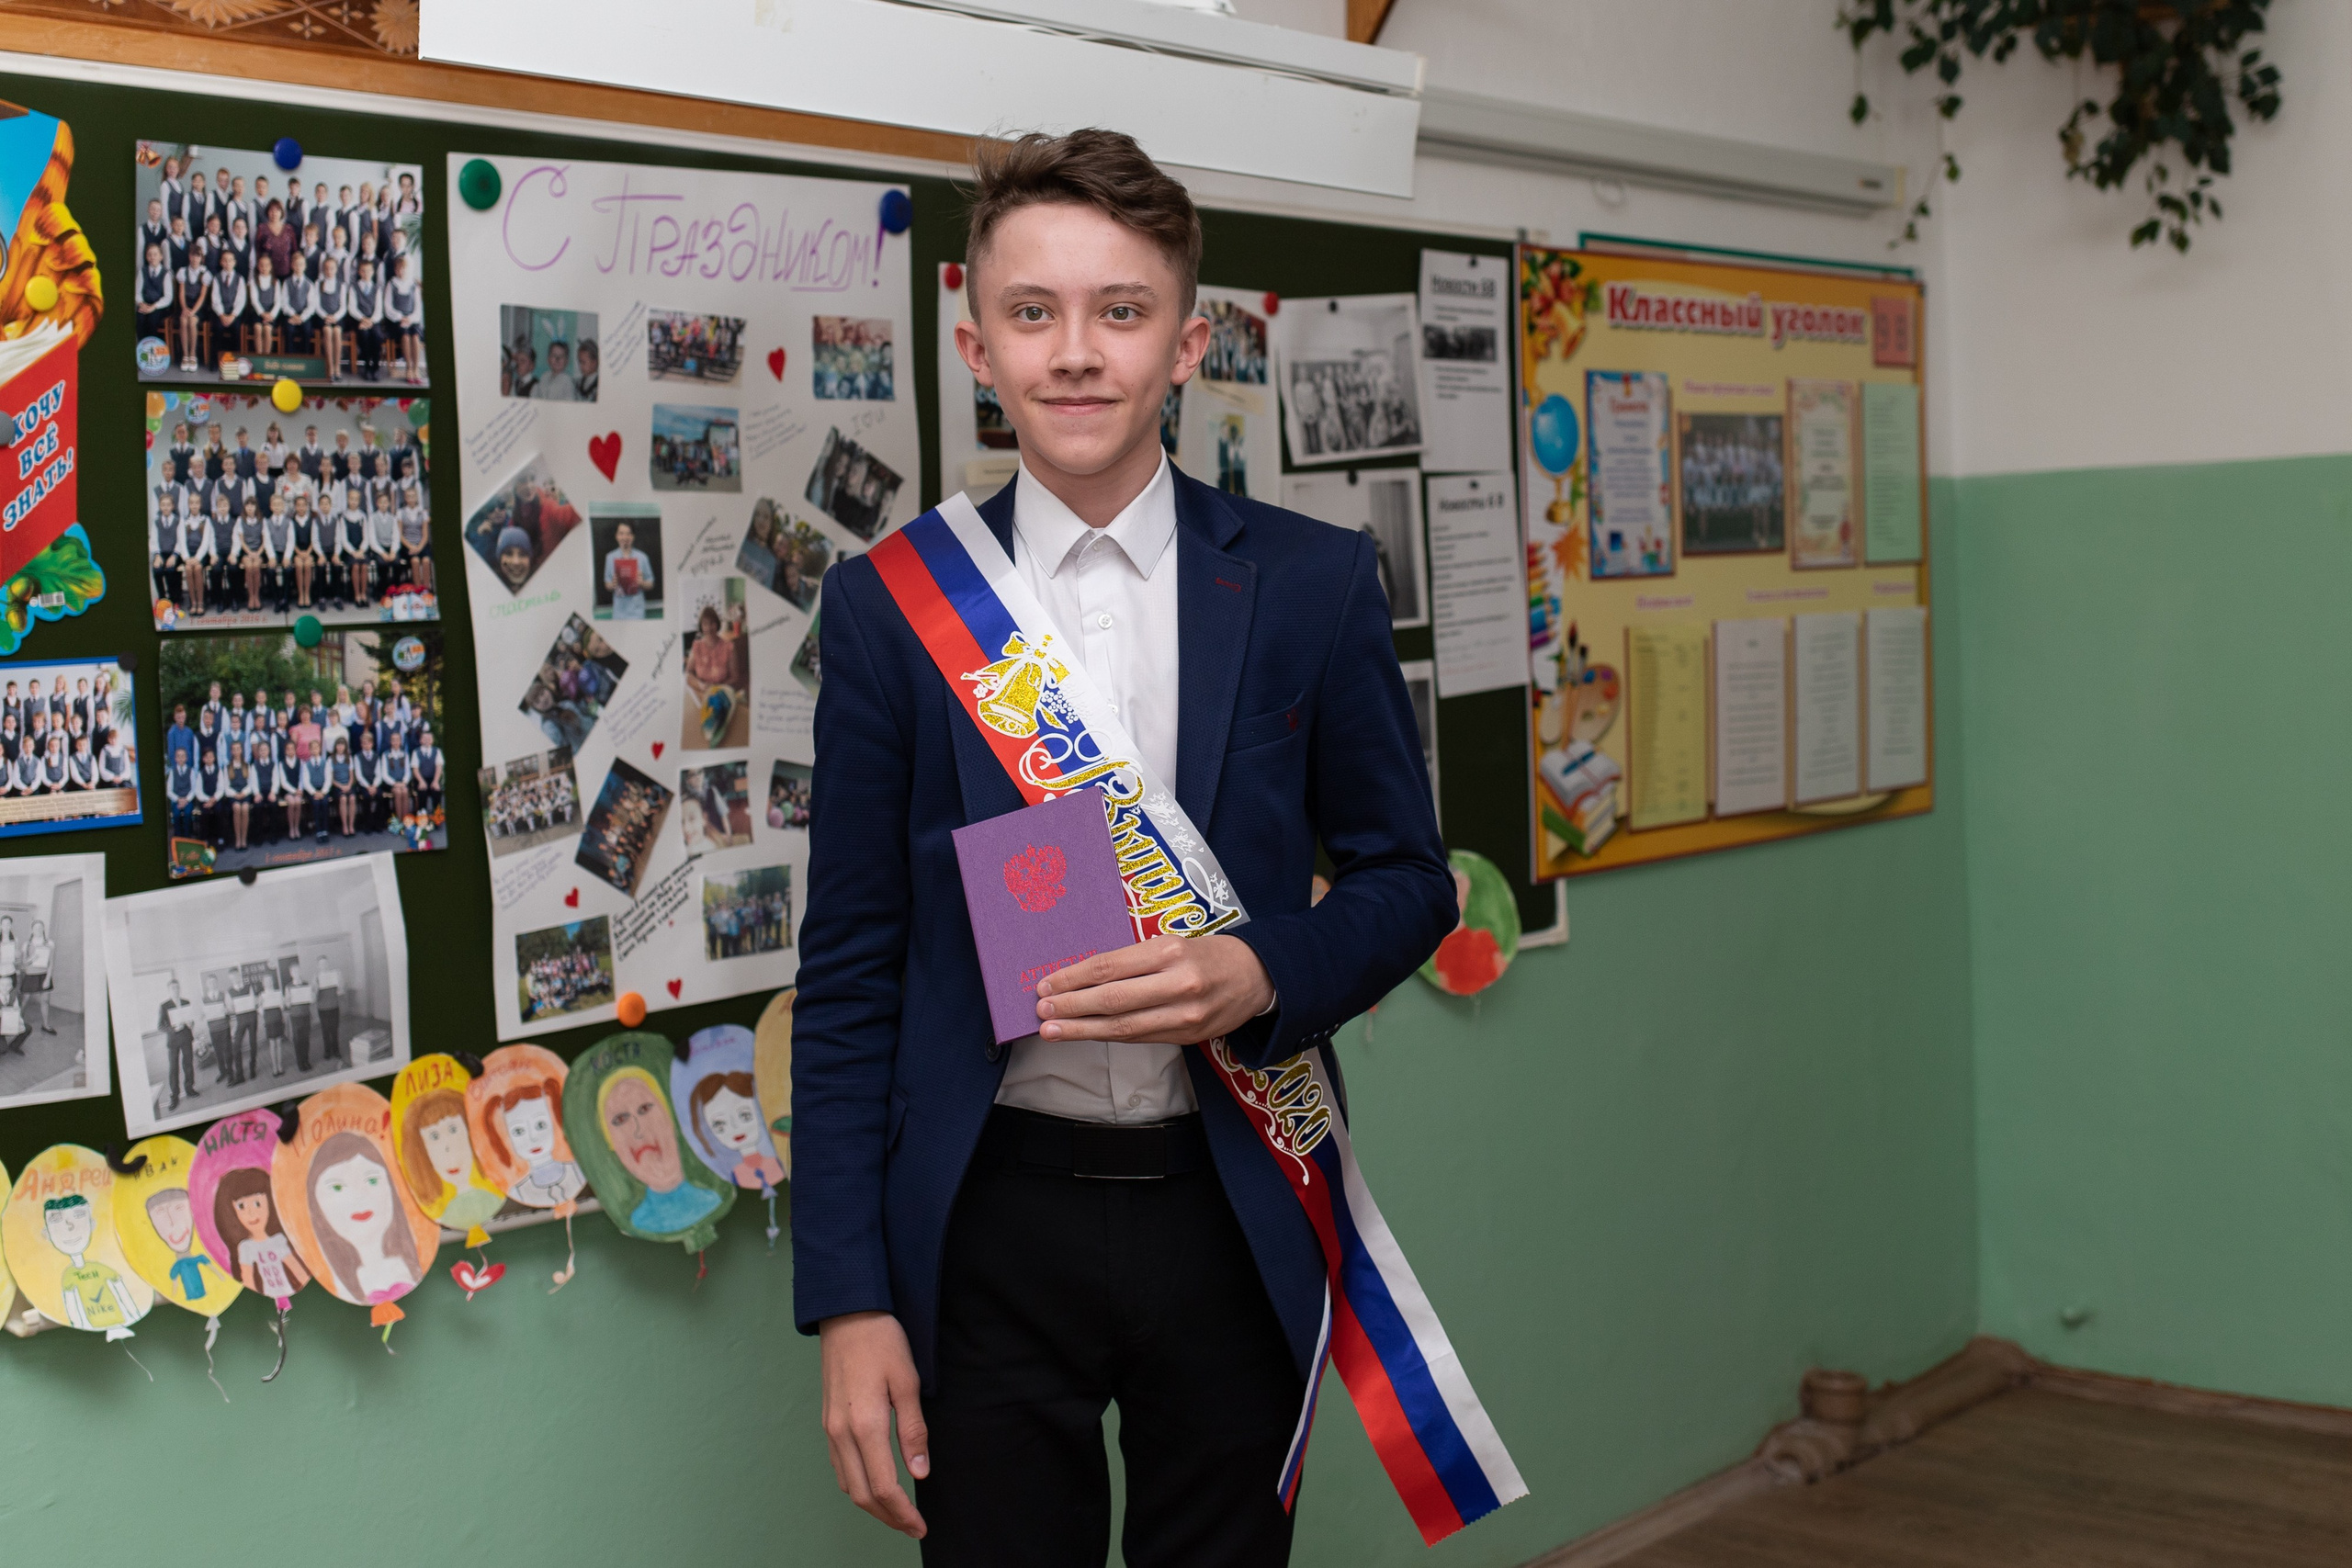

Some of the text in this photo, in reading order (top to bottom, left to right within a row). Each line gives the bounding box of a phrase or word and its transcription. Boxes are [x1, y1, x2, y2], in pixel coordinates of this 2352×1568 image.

[503, 165, 571, 272] С
[1607, 284, 1866, 347] Классный уголок
[9, 379, 65, 448] ХОЧУ
[18, 421, 59, 480] ВСЁ
[3, 446, 74, 532] ЗНАТЬ!
[403, 1061, 455, 1097] ЛИЗА
[203, 1120, 268, 1158] НАСТЯ
[290, 1110, 391, 1158] Полина!
[86, 1302, 115, 1316] Nike
